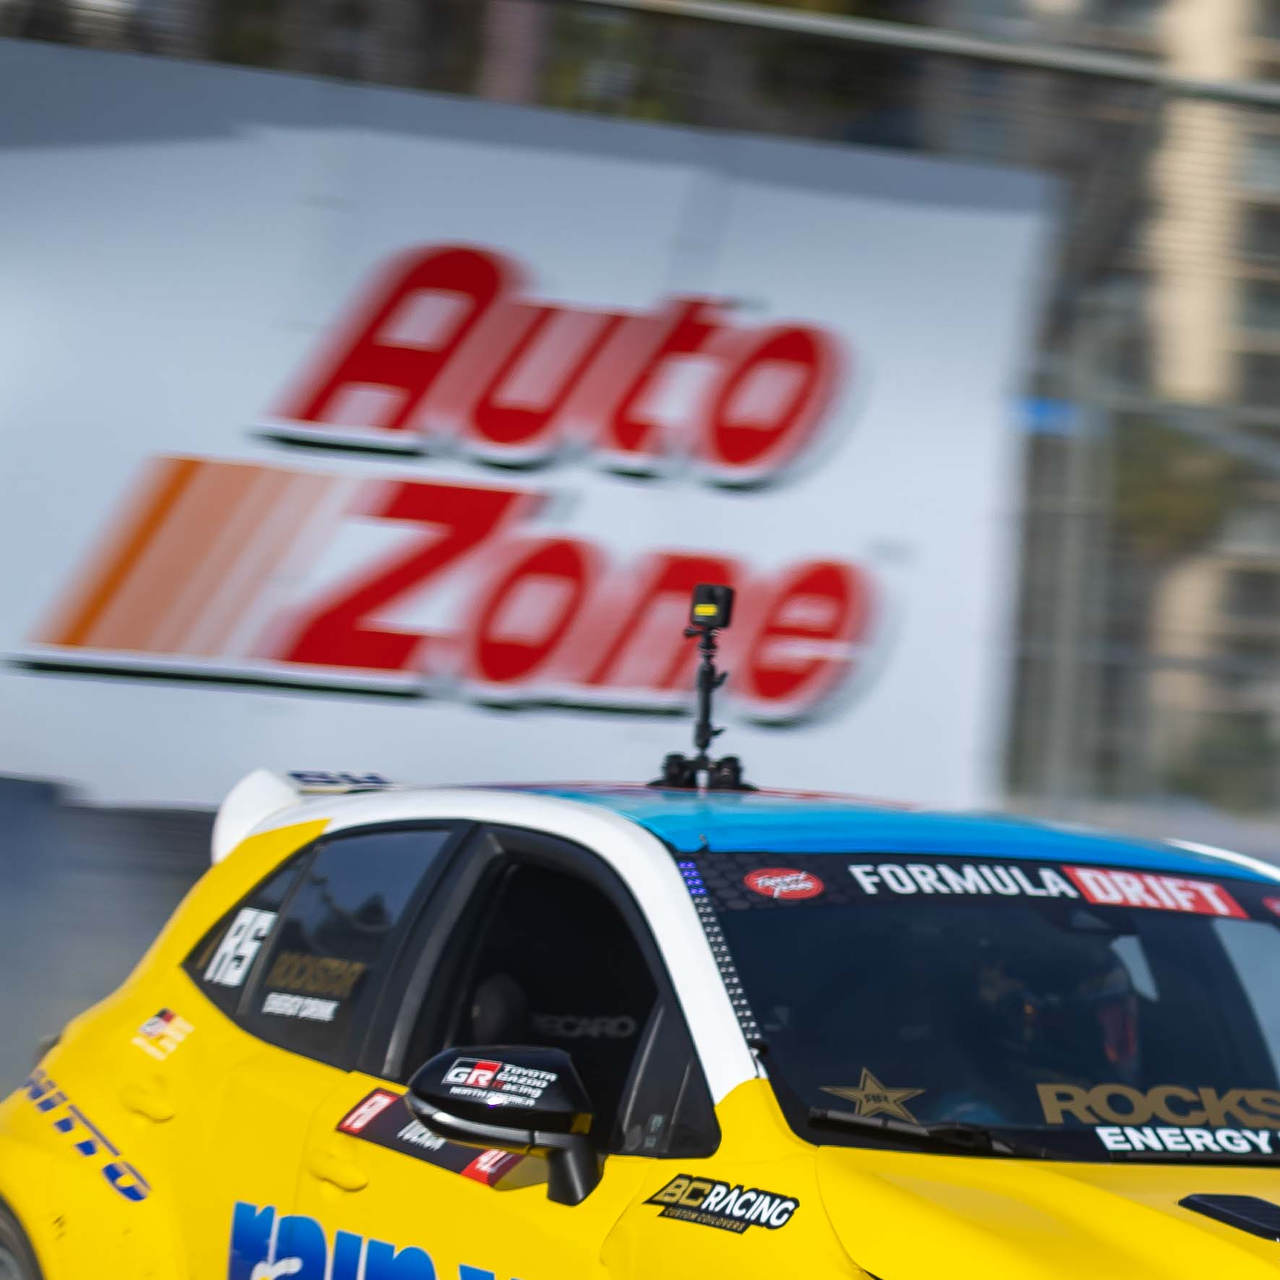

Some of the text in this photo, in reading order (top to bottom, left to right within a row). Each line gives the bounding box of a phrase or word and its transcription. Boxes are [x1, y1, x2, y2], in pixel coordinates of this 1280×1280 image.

[276, 242, 838, 470] Auto
[275, 478, 870, 706] Zone
[848, 863, 1079, 898] FORMULA
[1073, 866, 1231, 916] DRIFT
[447, 1066, 494, 1088] GR
[501, 1063, 558, 1082] TOYOTA
[1095, 1126, 1275, 1155] ENERGY
[649, 1176, 796, 1226] BC RACING
